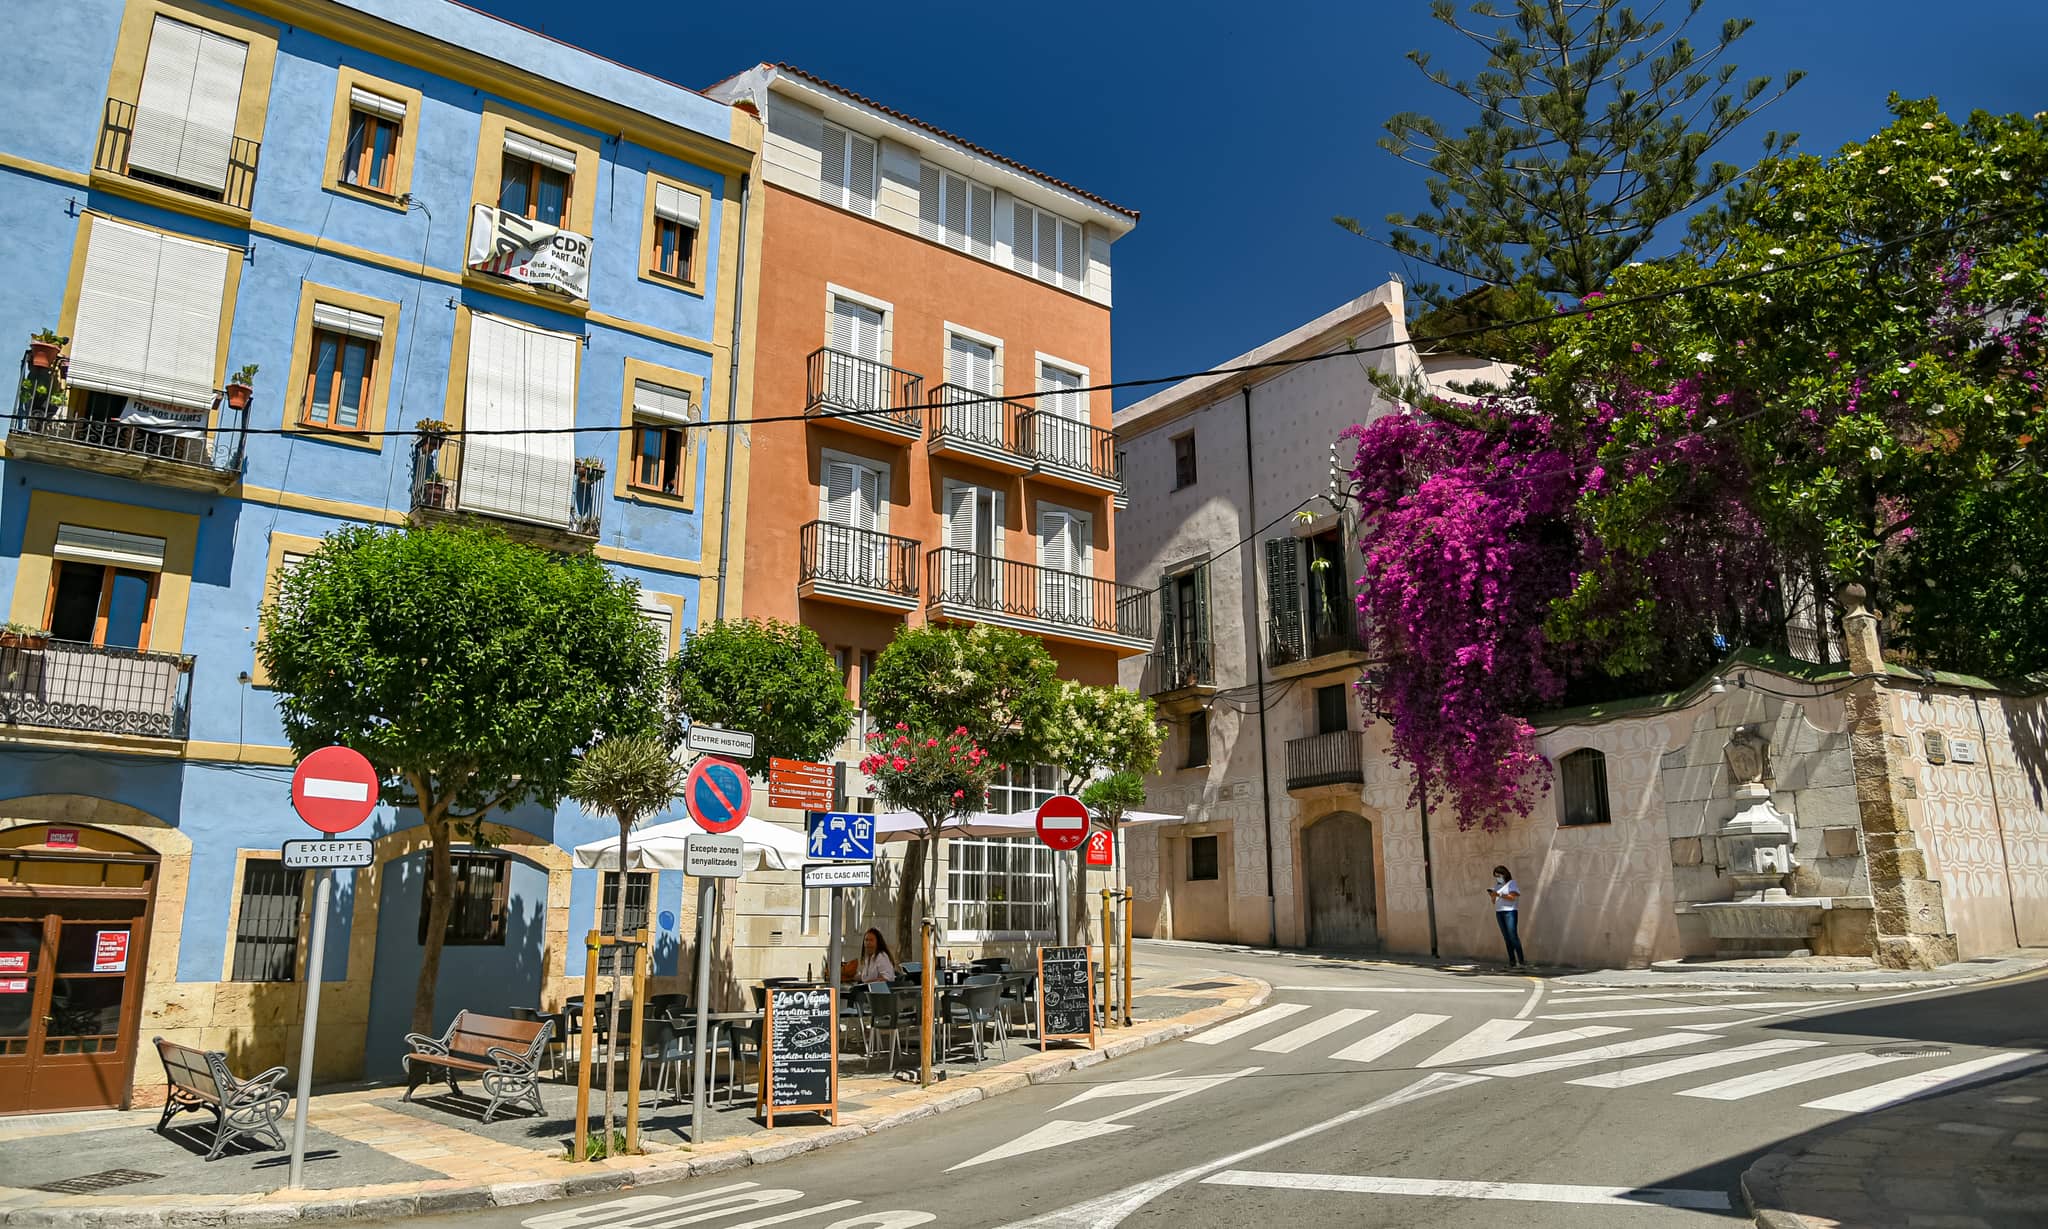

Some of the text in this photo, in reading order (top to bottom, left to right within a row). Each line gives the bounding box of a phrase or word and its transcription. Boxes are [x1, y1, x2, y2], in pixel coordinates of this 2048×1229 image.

[552, 236, 587, 258] CDR
[551, 250, 585, 268] PART ALTA
[692, 734, 751, 749] CENTRE HISTORIC
[301, 843, 362, 853] EXCEPTE
[690, 844, 740, 855] Excepte zones
[286, 855, 373, 864] AUTORITZATS
[691, 857, 738, 867] senyalitzades
[794, 991, 830, 1009] Vegas
